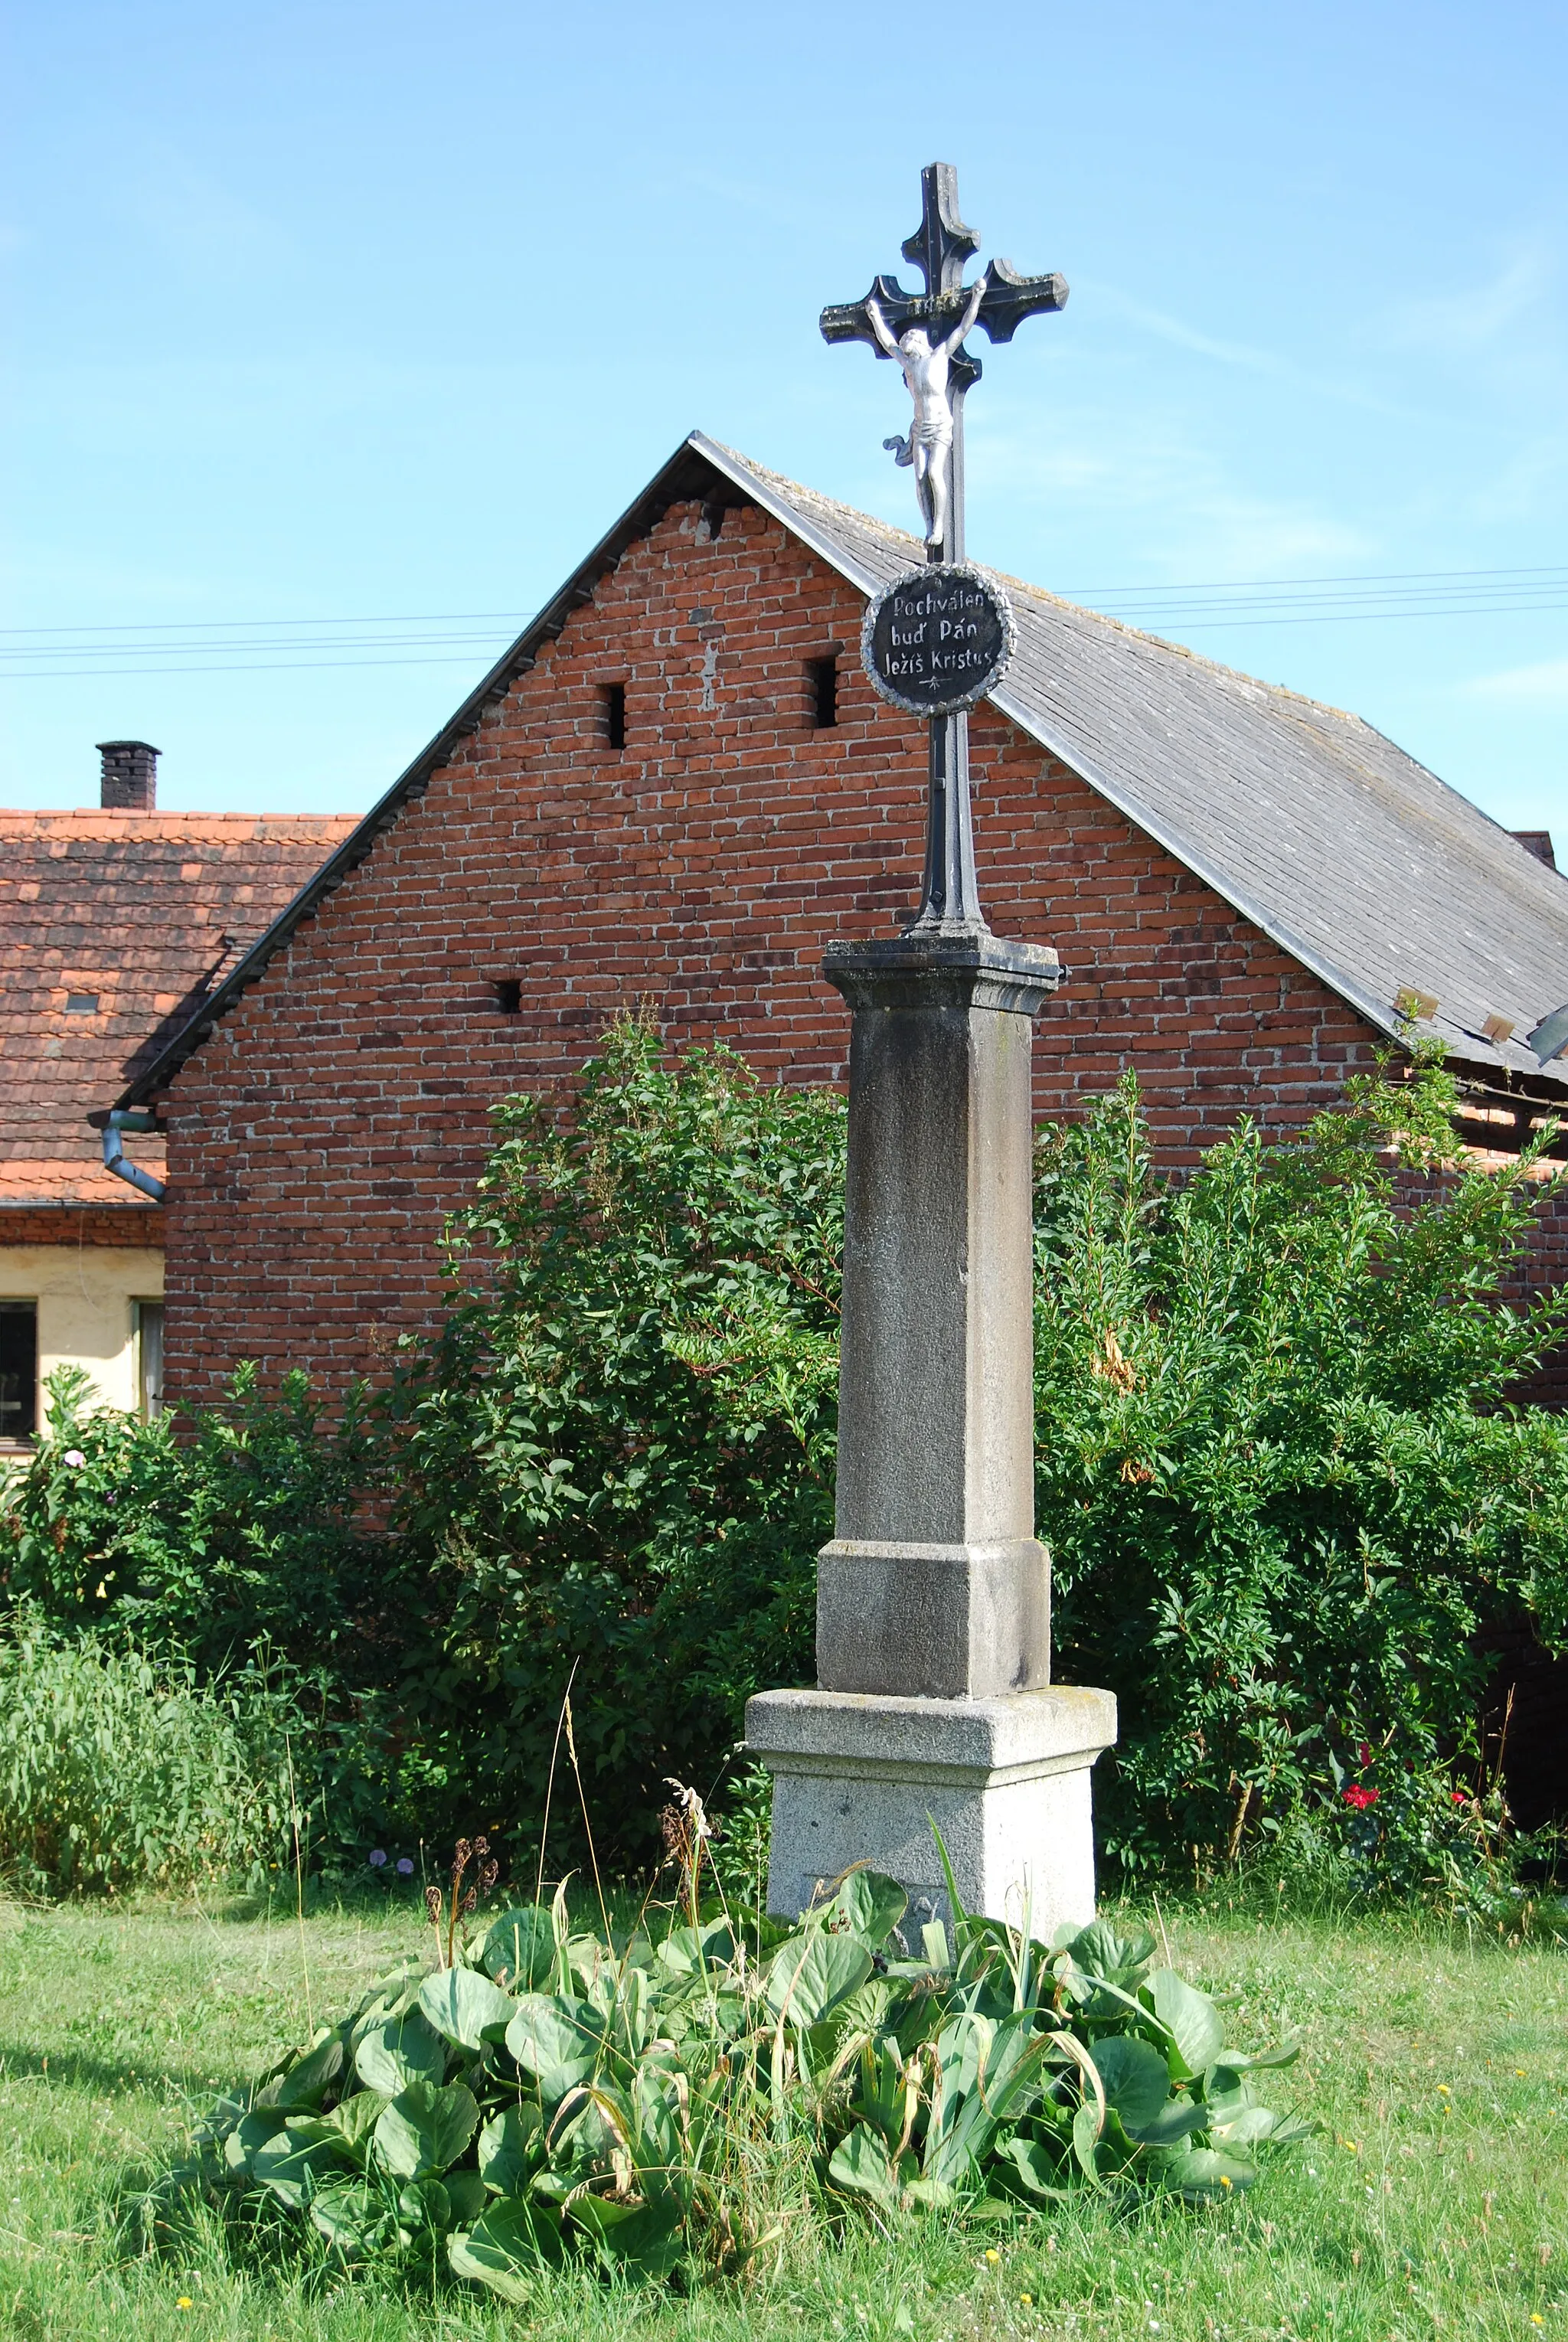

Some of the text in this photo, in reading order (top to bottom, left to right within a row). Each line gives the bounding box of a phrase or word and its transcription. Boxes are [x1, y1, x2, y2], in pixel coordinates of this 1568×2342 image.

[894, 590, 985, 616] Pochválen
[890, 618, 977, 646] buď Pán
[883, 648, 993, 678] Ježíš Kristus
